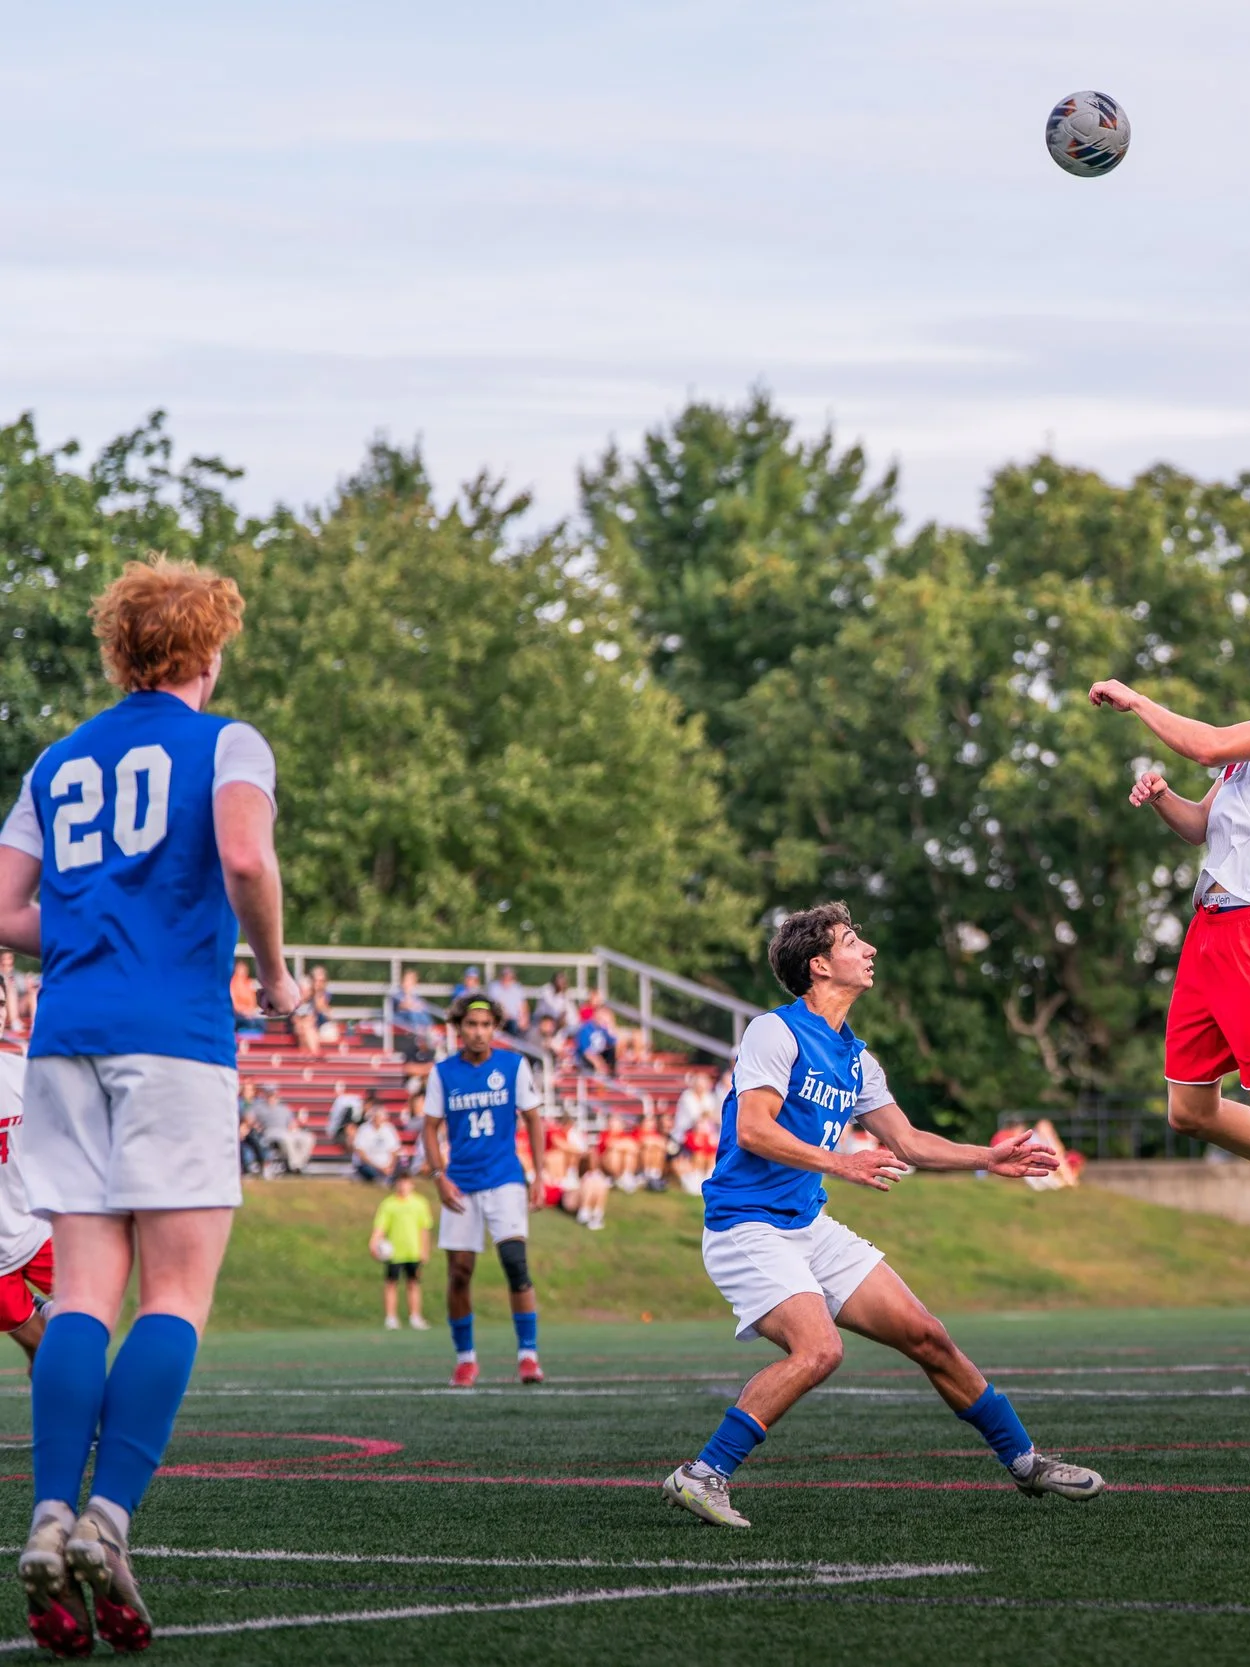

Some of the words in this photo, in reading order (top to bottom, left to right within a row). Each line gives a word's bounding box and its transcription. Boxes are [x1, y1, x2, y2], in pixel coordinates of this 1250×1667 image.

[50, 744, 173, 873] 20
[448, 1089, 509, 1111] HARTWICK
[468, 1109, 495, 1138] 14
